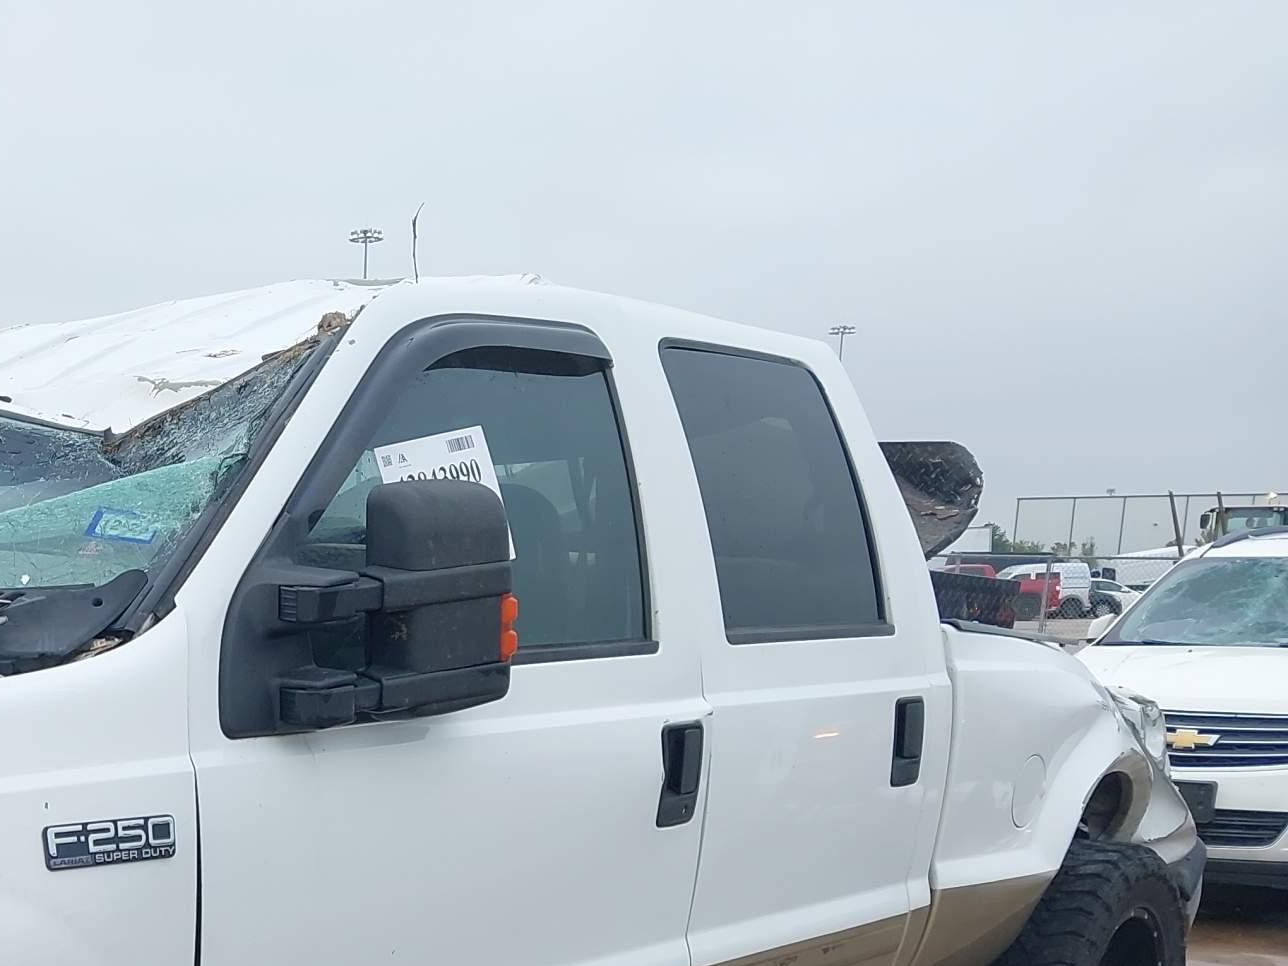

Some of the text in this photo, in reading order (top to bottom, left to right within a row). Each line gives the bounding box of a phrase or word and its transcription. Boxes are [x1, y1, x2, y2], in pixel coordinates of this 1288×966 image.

[399, 458, 482, 483] 3990
[95, 845, 175, 863] SUPER DUTY
